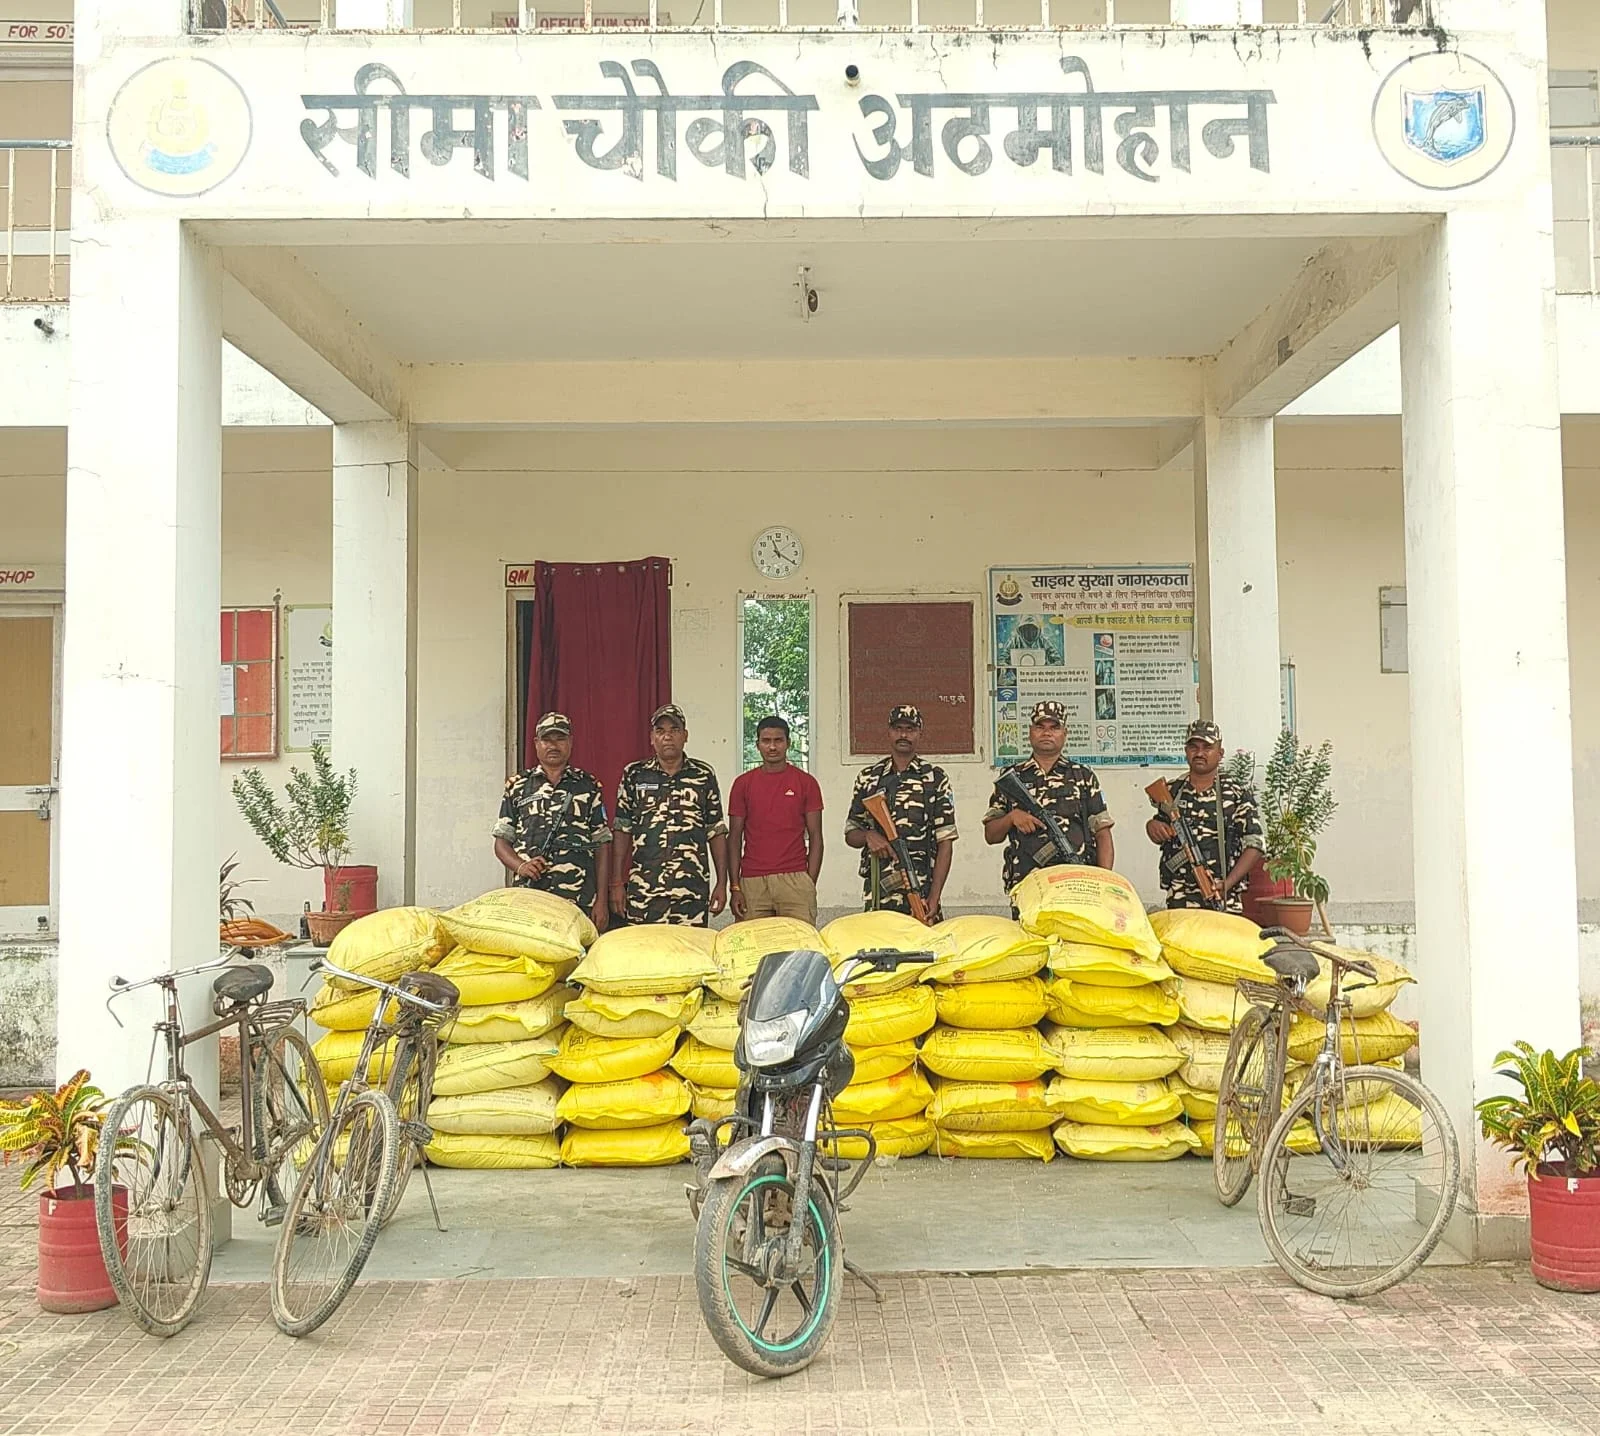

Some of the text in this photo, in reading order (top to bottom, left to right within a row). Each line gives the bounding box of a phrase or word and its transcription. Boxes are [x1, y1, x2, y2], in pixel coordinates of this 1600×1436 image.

[8, 25, 39, 39] FOR
[300, 56, 1278, 183] सीमा चौकी अठमोहान
[0, 570, 36, 584] SHOP
[508, 569, 529, 584] QM
[1031, 573, 1189, 591] साइबर सुरक्षा जागरूकता
[48, 1198, 57, 1216] F
